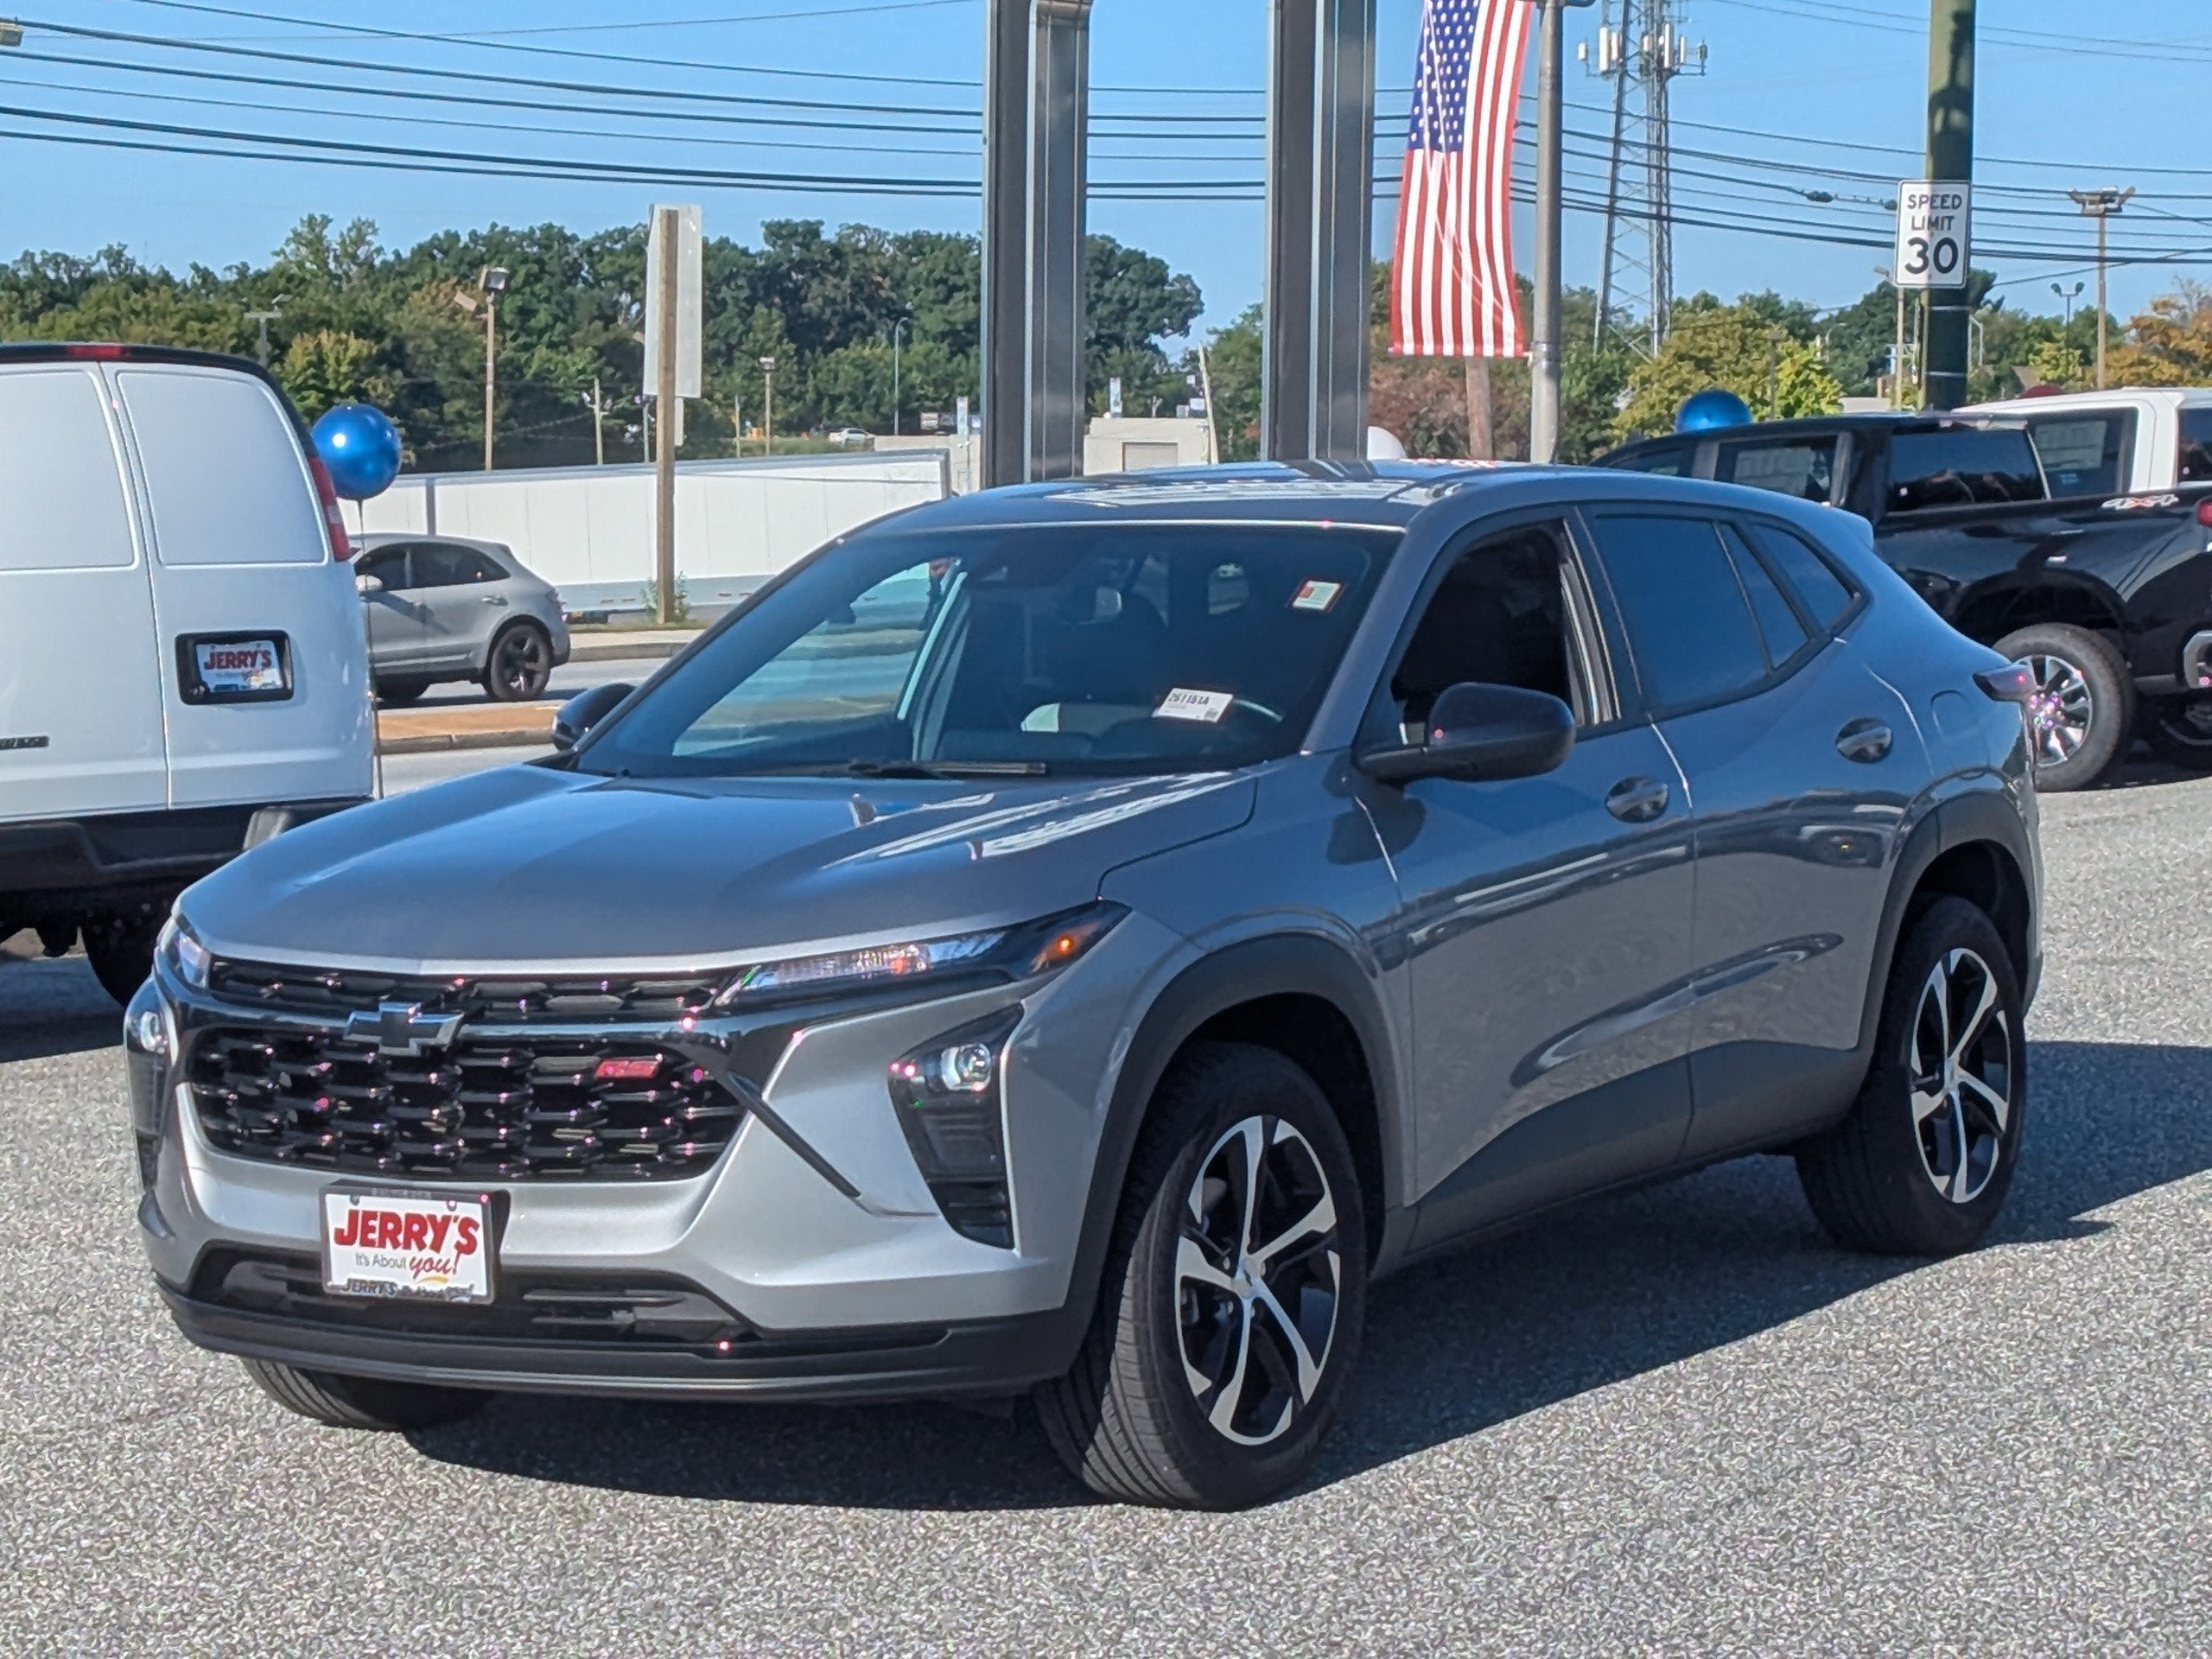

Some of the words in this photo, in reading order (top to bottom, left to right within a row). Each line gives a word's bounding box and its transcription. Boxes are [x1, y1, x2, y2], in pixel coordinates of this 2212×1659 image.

[1907, 194, 1962, 209] SPEED
[1911, 215, 1955, 231] LIMIT
[1904, 237, 1958, 274] 30
[204, 650, 271, 670] JERRY'S
[595, 1060, 657, 1077] RS
[334, 1209, 480, 1255] JERRY'S
[356, 1253, 370, 1266] It's
[372, 1255, 407, 1269] About
[409, 1253, 461, 1279] you!
